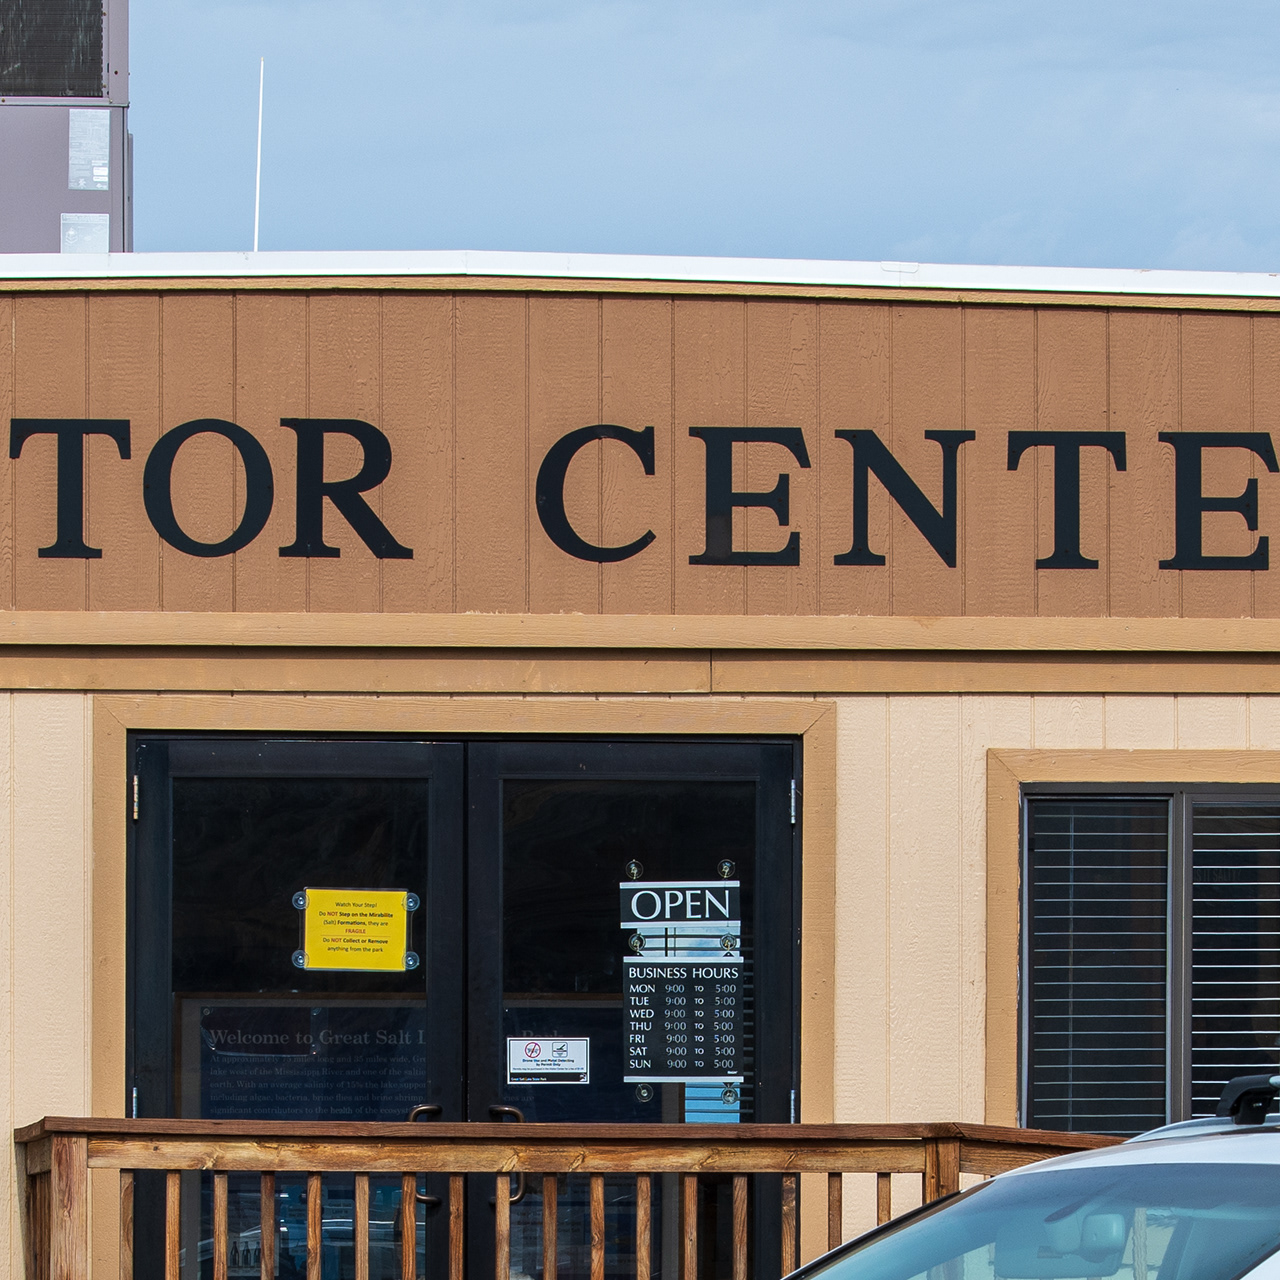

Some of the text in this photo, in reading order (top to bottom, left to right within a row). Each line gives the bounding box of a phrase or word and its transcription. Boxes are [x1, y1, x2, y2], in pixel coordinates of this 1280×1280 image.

[631, 890, 730, 919] OPEN
[629, 967, 738, 978] BUSINESS HOURS
[630, 984, 655, 993] MON
[716, 984, 736, 993] 5:00
[630, 997, 649, 1005] TUE
[666, 997, 686, 1005] 9:00
[715, 997, 735, 1005] 5:00
[630, 1009, 654, 1018] WED
[665, 1010, 685, 1018] 9:00
[715, 1010, 734, 1018] 5:00
[630, 1022, 652, 1031] THU
[665, 1022, 686, 1030] 9:00
[714, 1022, 733, 1030] 5:00
[210, 1030, 289, 1044] Welcome
[295, 1031, 313, 1044] to
[320, 1030, 370, 1044] Great
[376, 1030, 411, 1044] Salt
[630, 1034, 644, 1043] FRI
[666, 1034, 687, 1043] 9:00
[714, 1035, 734, 1043] 5:00
[630, 1047, 647, 1056] SAT
[666, 1047, 687, 1055] 9:00
[716, 1047, 735, 1055] 5:00
[630, 1059, 651, 1068] SUN
[667, 1060, 686, 1068] 9:00
[714, 1060, 733, 1068] 5:00
